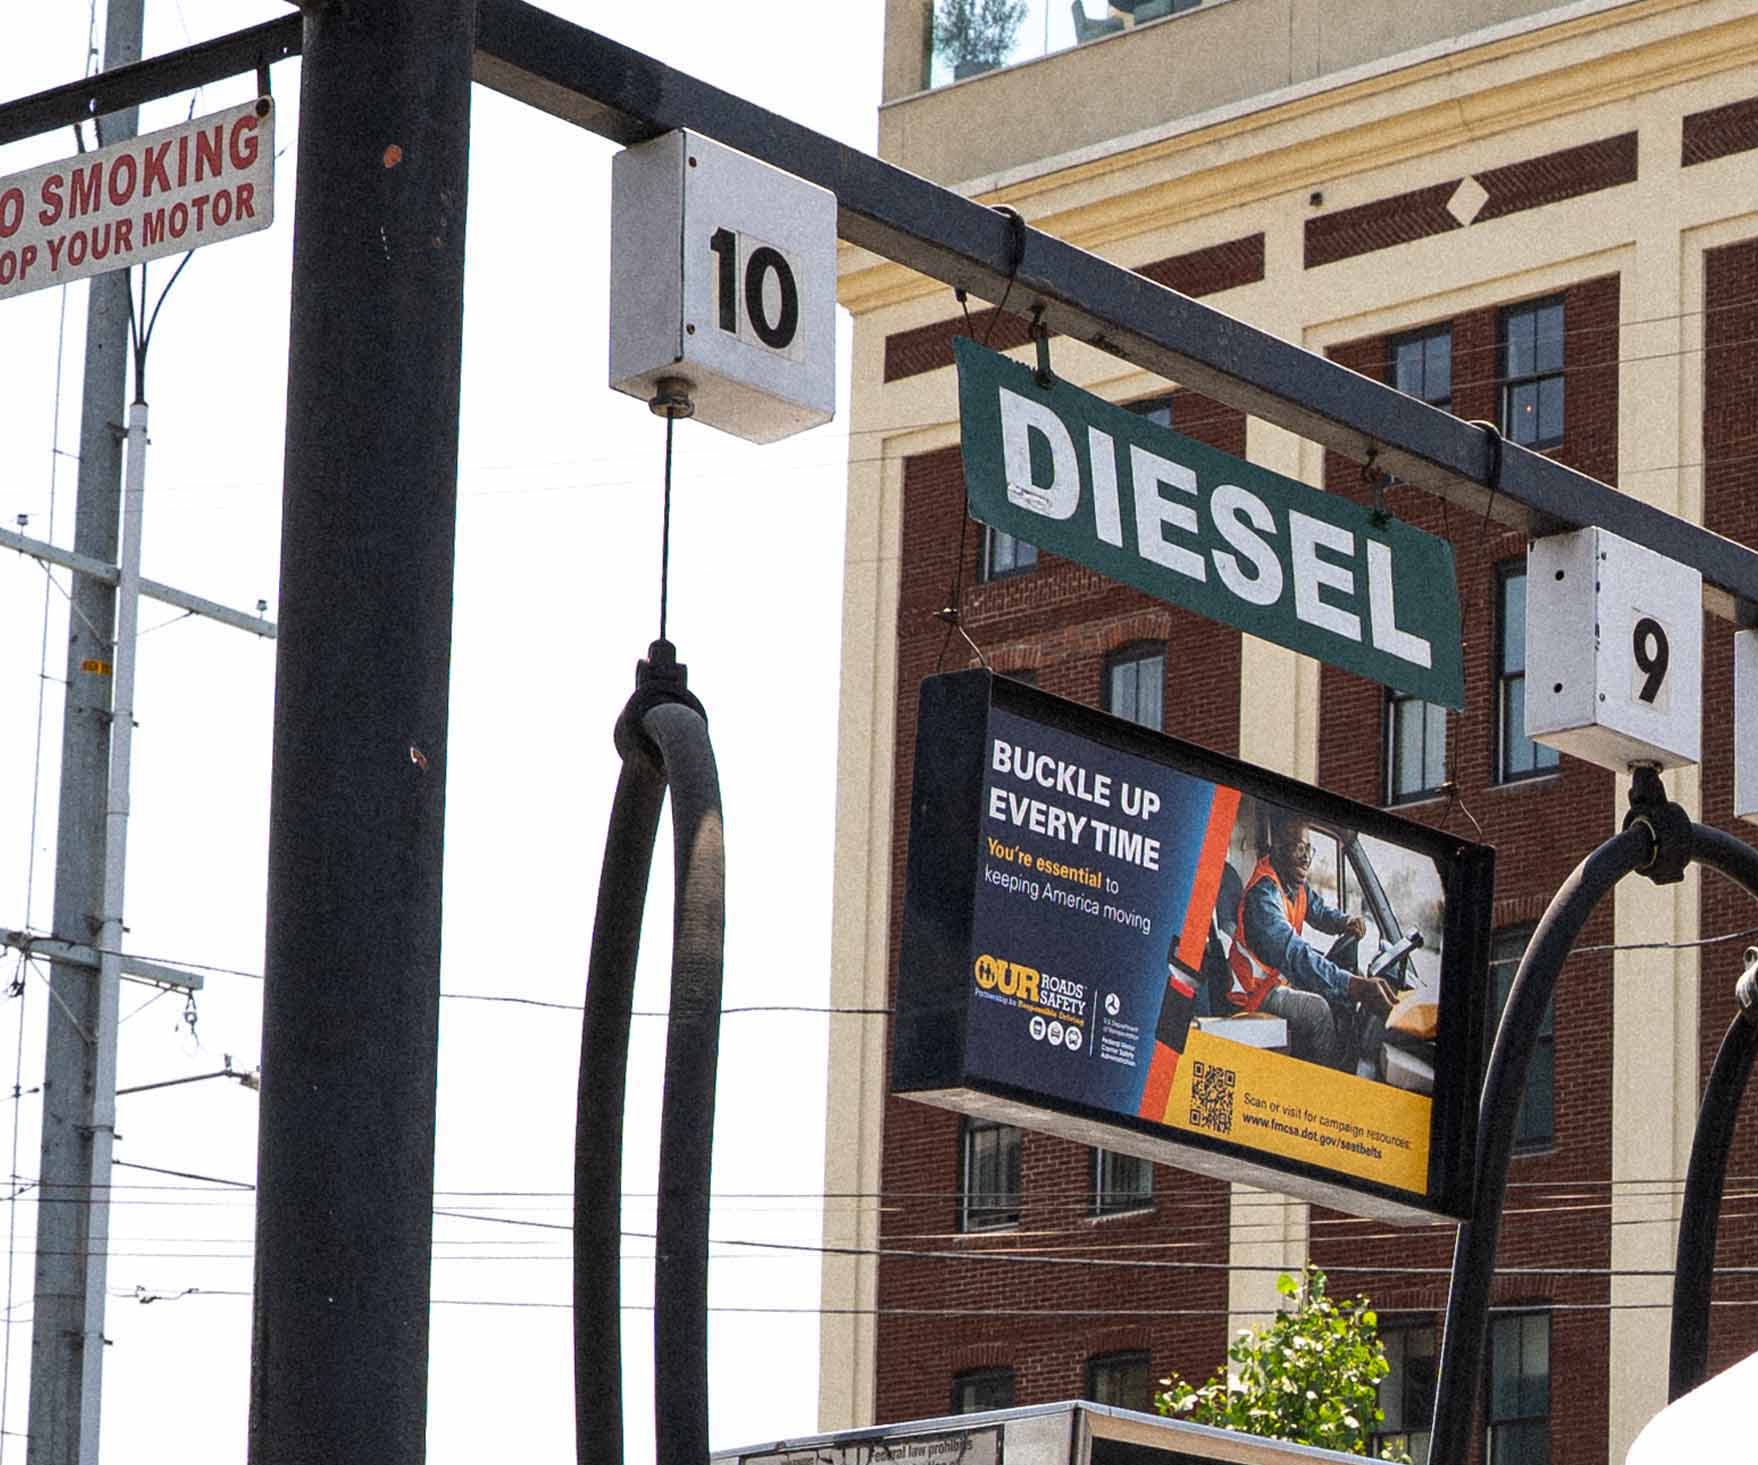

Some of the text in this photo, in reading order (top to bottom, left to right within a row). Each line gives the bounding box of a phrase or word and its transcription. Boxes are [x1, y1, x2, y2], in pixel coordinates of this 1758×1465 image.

[0, 114, 259, 238] O SMOKING
[0, 183, 256, 285] OP YOUR MOTOR
[709, 226, 800, 350] 10
[1000, 385, 1432, 669] DIESEL
[1632, 617, 1670, 705] 9
[992, 739, 1161, 820] BUCKLE UP
[987, 836, 1119, 894] You're essential to
[988, 786, 1161, 871] EVERY TIME
[985, 864, 1151, 936] keeping America moving
[974, 953, 1041, 1002] OUR
[1039, 990, 1086, 1015] SAFETY
[1041, 974, 1084, 999] ROADS
[1243, 1093, 1266, 1109] Scan
[1269, 1101, 1280, 1113] or
[1282, 1105, 1302, 1119] visit
[1303, 1109, 1317, 1123] for
[1319, 1116, 1365, 1138] campaign
[908, 1445, 926, 1457] law
